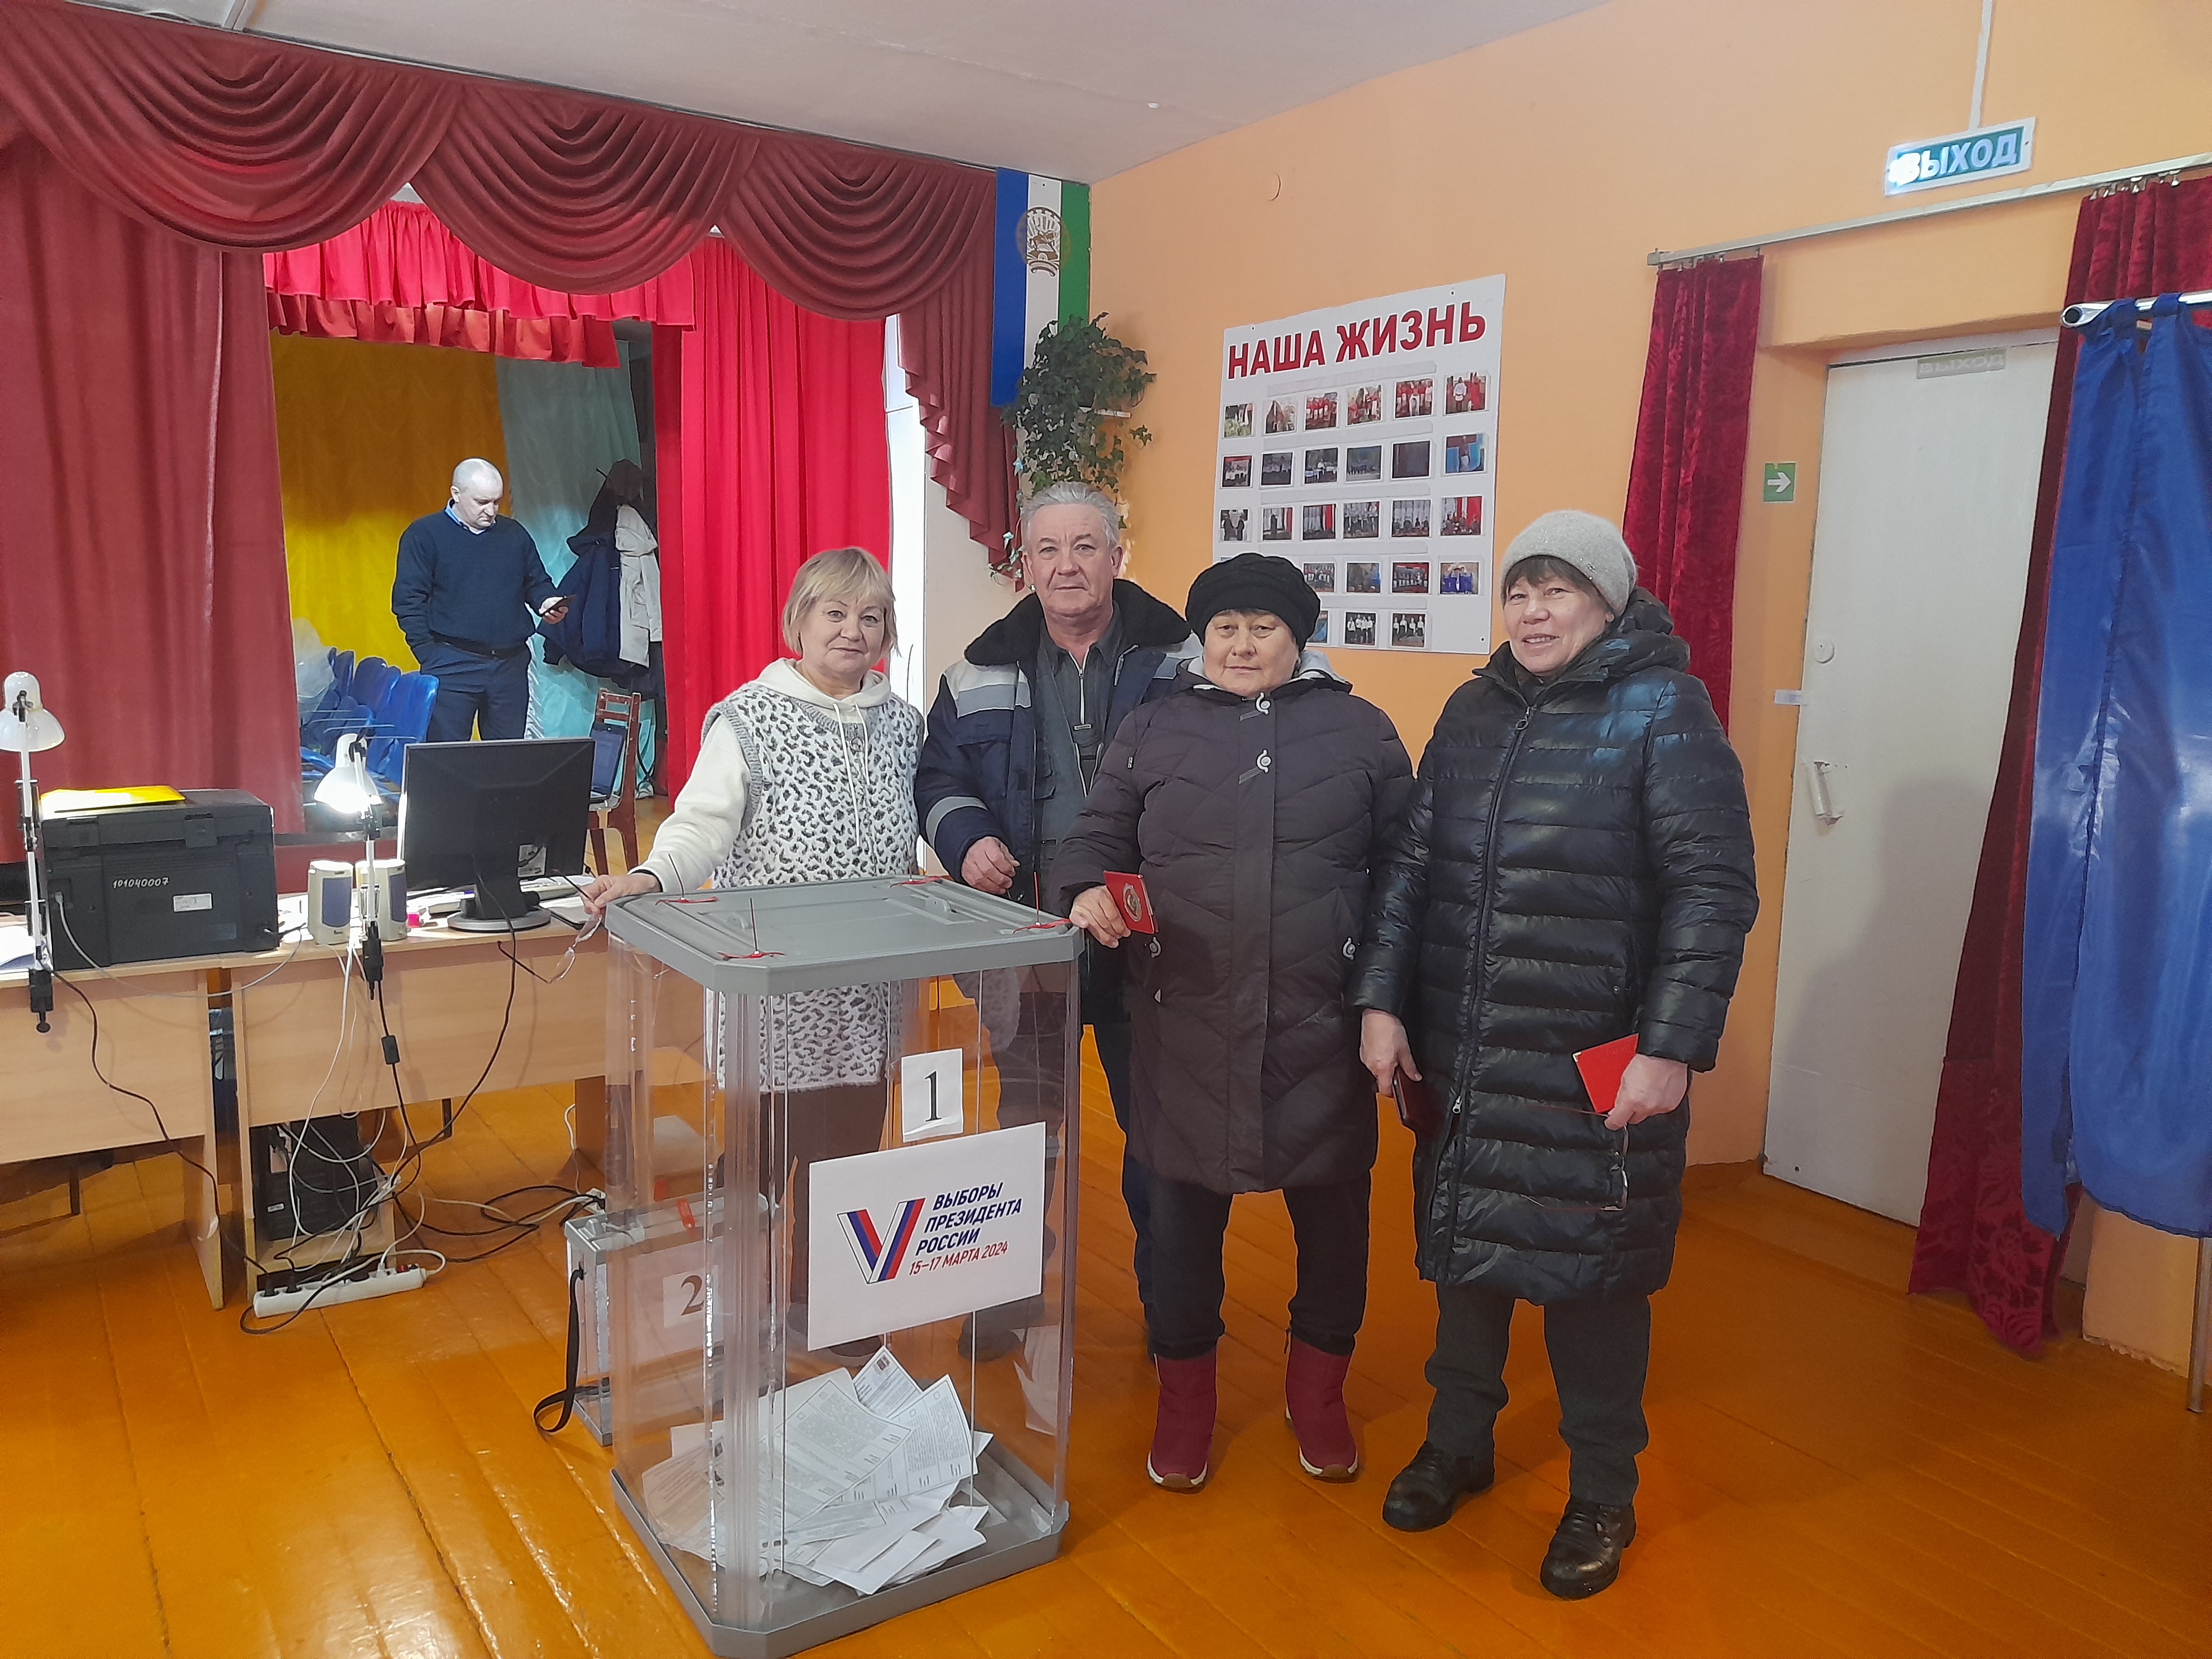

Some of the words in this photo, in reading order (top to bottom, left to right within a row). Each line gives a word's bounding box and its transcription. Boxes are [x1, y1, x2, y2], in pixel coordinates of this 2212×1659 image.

[1889, 133, 2017, 186] ЫХОД
[1228, 330, 1326, 379] НАША
[1335, 301, 1486, 363] ЖИЗНЬ
[1919, 354, 2005, 373] ВЫХОД
[113, 877, 170, 889] 101040007
[925, 1070, 942, 1123] 1
[932, 1182, 1004, 1211] ВЫБОРЫ
[924, 1198, 1022, 1233] ПРЕЗИДЕНТА
[915, 1227, 980, 1256] РОССИИ
[942, 1247, 980, 1268] МАРТА
[981, 1241, 1009, 1259] 2024
[681, 1275, 704, 1316] 2
